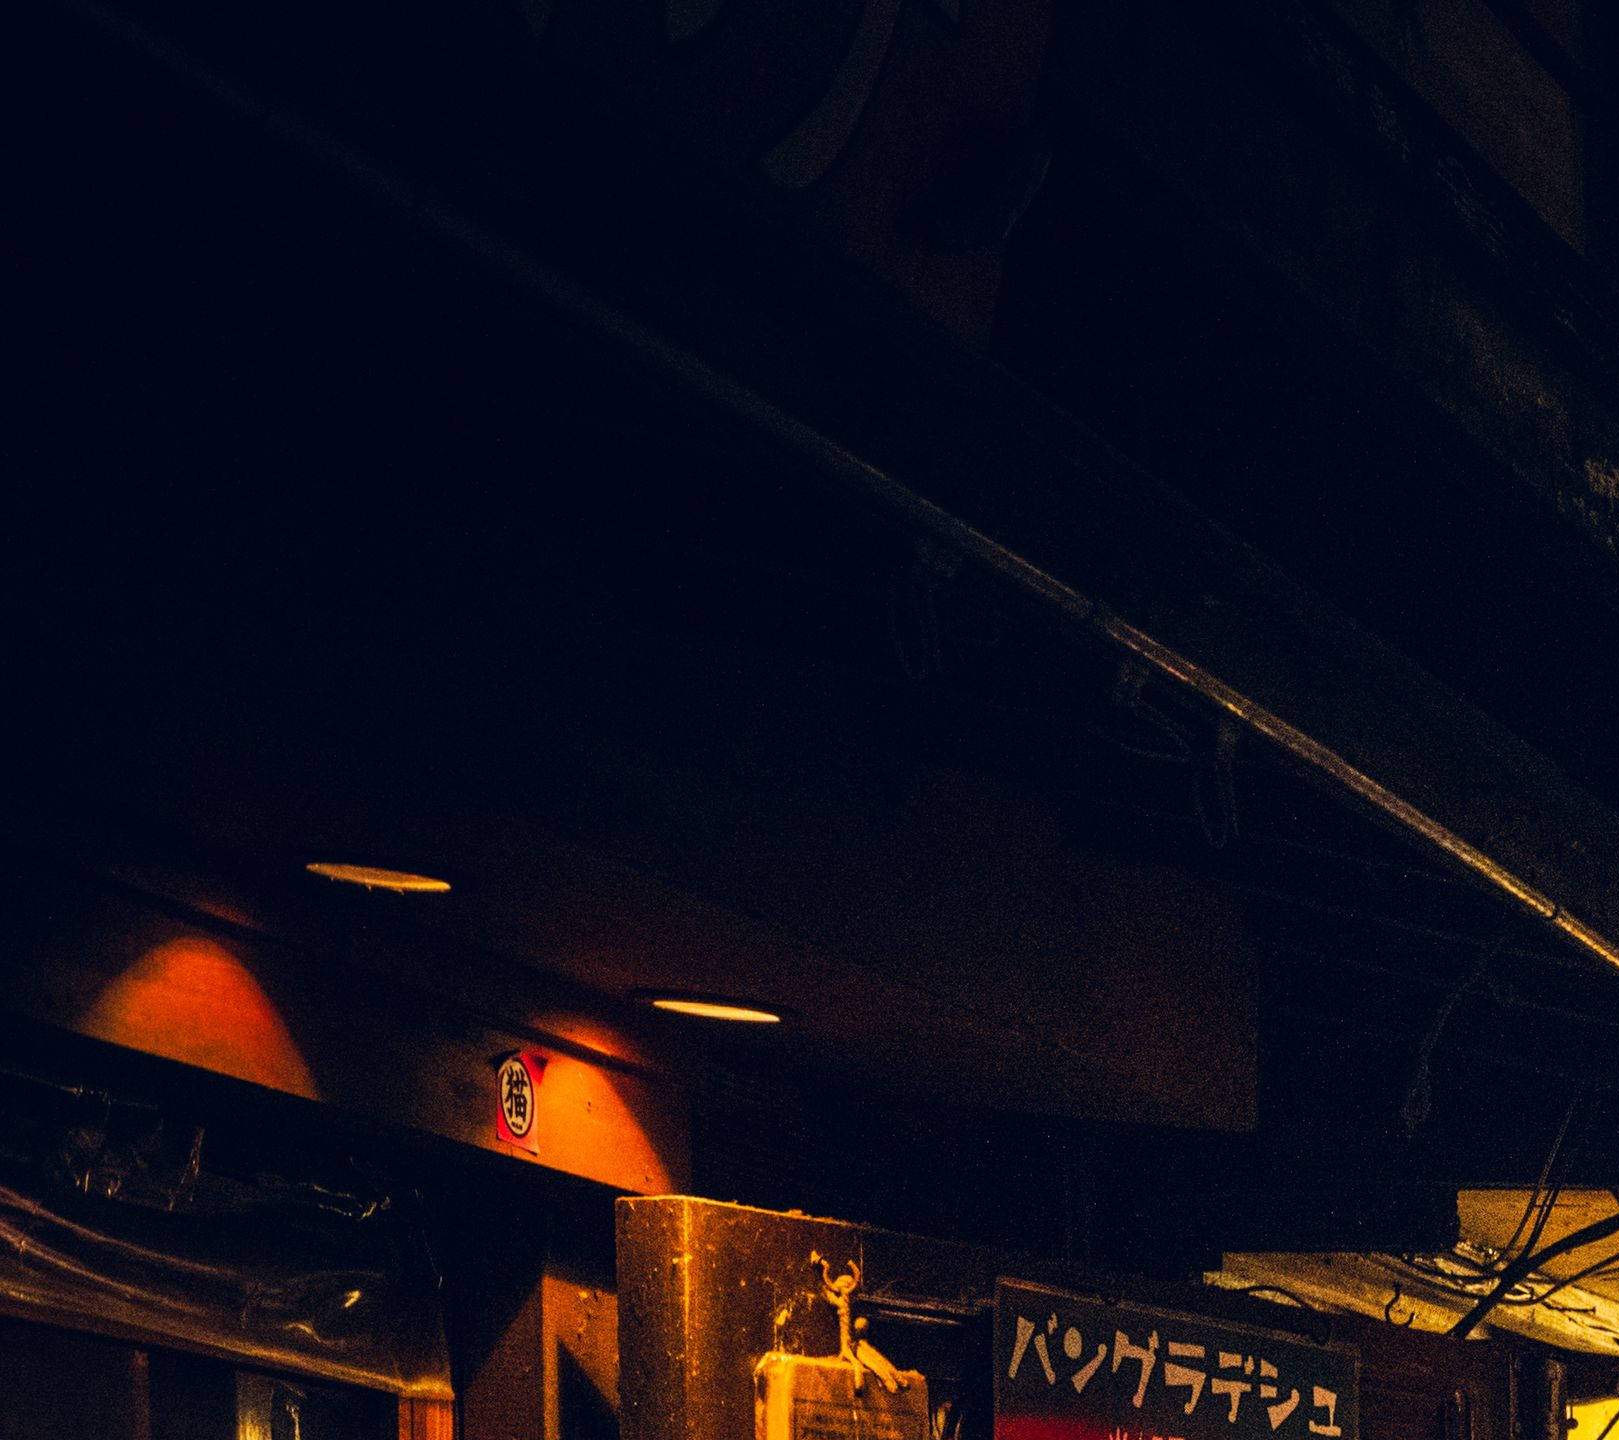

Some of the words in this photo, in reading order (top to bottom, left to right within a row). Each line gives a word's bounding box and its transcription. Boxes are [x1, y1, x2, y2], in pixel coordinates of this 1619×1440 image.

[504, 1064, 528, 1123] 猫
[1008, 1313, 1342, 1438] バングラデシュ
